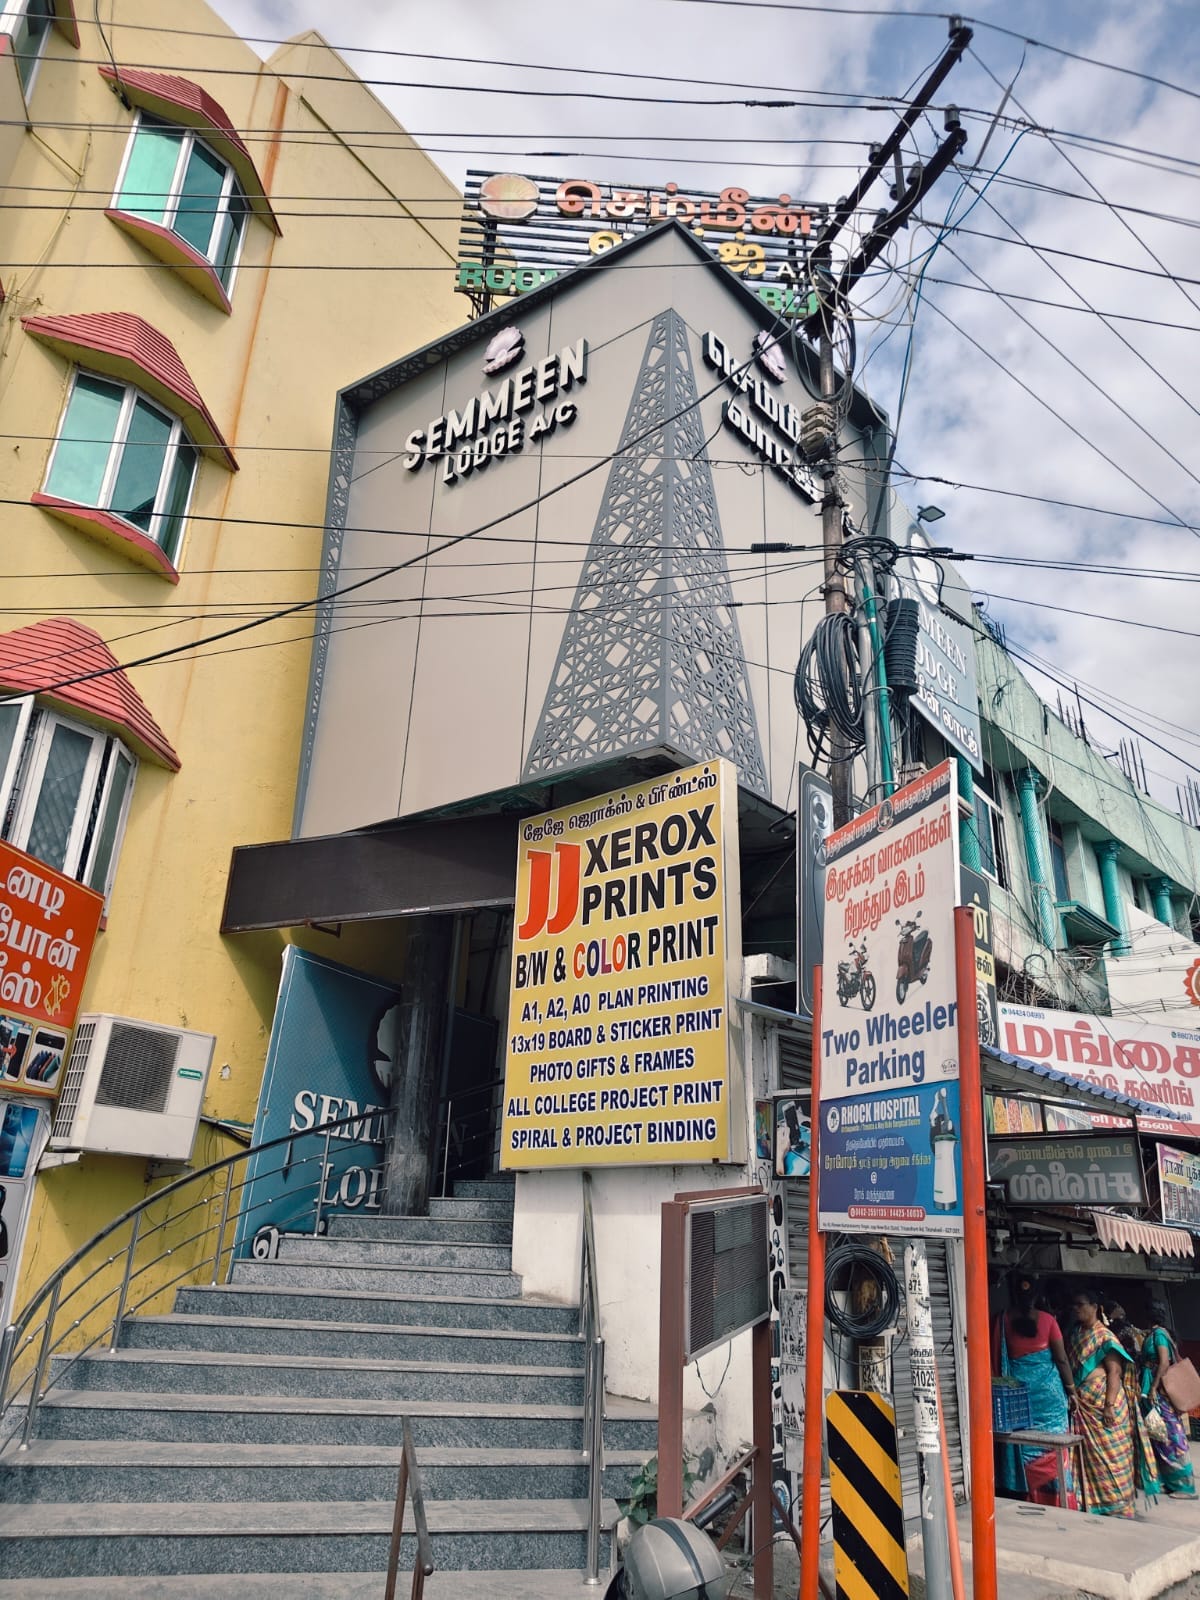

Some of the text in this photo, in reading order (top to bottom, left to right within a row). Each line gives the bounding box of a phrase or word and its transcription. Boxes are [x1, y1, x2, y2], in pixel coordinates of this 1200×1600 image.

[555, 180, 816, 236] செம்மீன்
[403, 337, 588, 471] SEMMEEN
[443, 401, 577, 484] LODGE A/C
[523, 818, 564, 841] ஜேஜே
[569, 794, 632, 829] ஜெராக்ஸ்
[636, 795, 645, 809] &
[518, 804, 717, 940] JJ XEROX
[825, 804, 951, 900] இருசக்கர வாகனங்கள்
[582, 856, 718, 926] PRINTS
[844, 863, 925, 939] நிறுத்தும் இடம்
[515, 916, 718, 988] B/W & COLOR PRINT
[521, 1001, 543, 1025] A1,
[546, 997, 568, 1021] A2,
[598, 988, 634, 1011] PLAN
[637, 976, 709, 1000] PRINTING
[511, 1008, 723, 1054] 13x19 BOARD & STICKER PRINT
[822, 1001, 958, 1057] Two Wheeler
[530, 1047, 695, 1083] PHOTO GIFTS & FRAMES
[846, 1050, 925, 1087] Parking
[507, 1080, 723, 1117] ALL COLLEGE PROJECT PRINT
[841, 1095, 921, 1125] RHOCK HOSPITAL
[511, 1119, 716, 1149] SPIRAL & PROJECT BINDING
